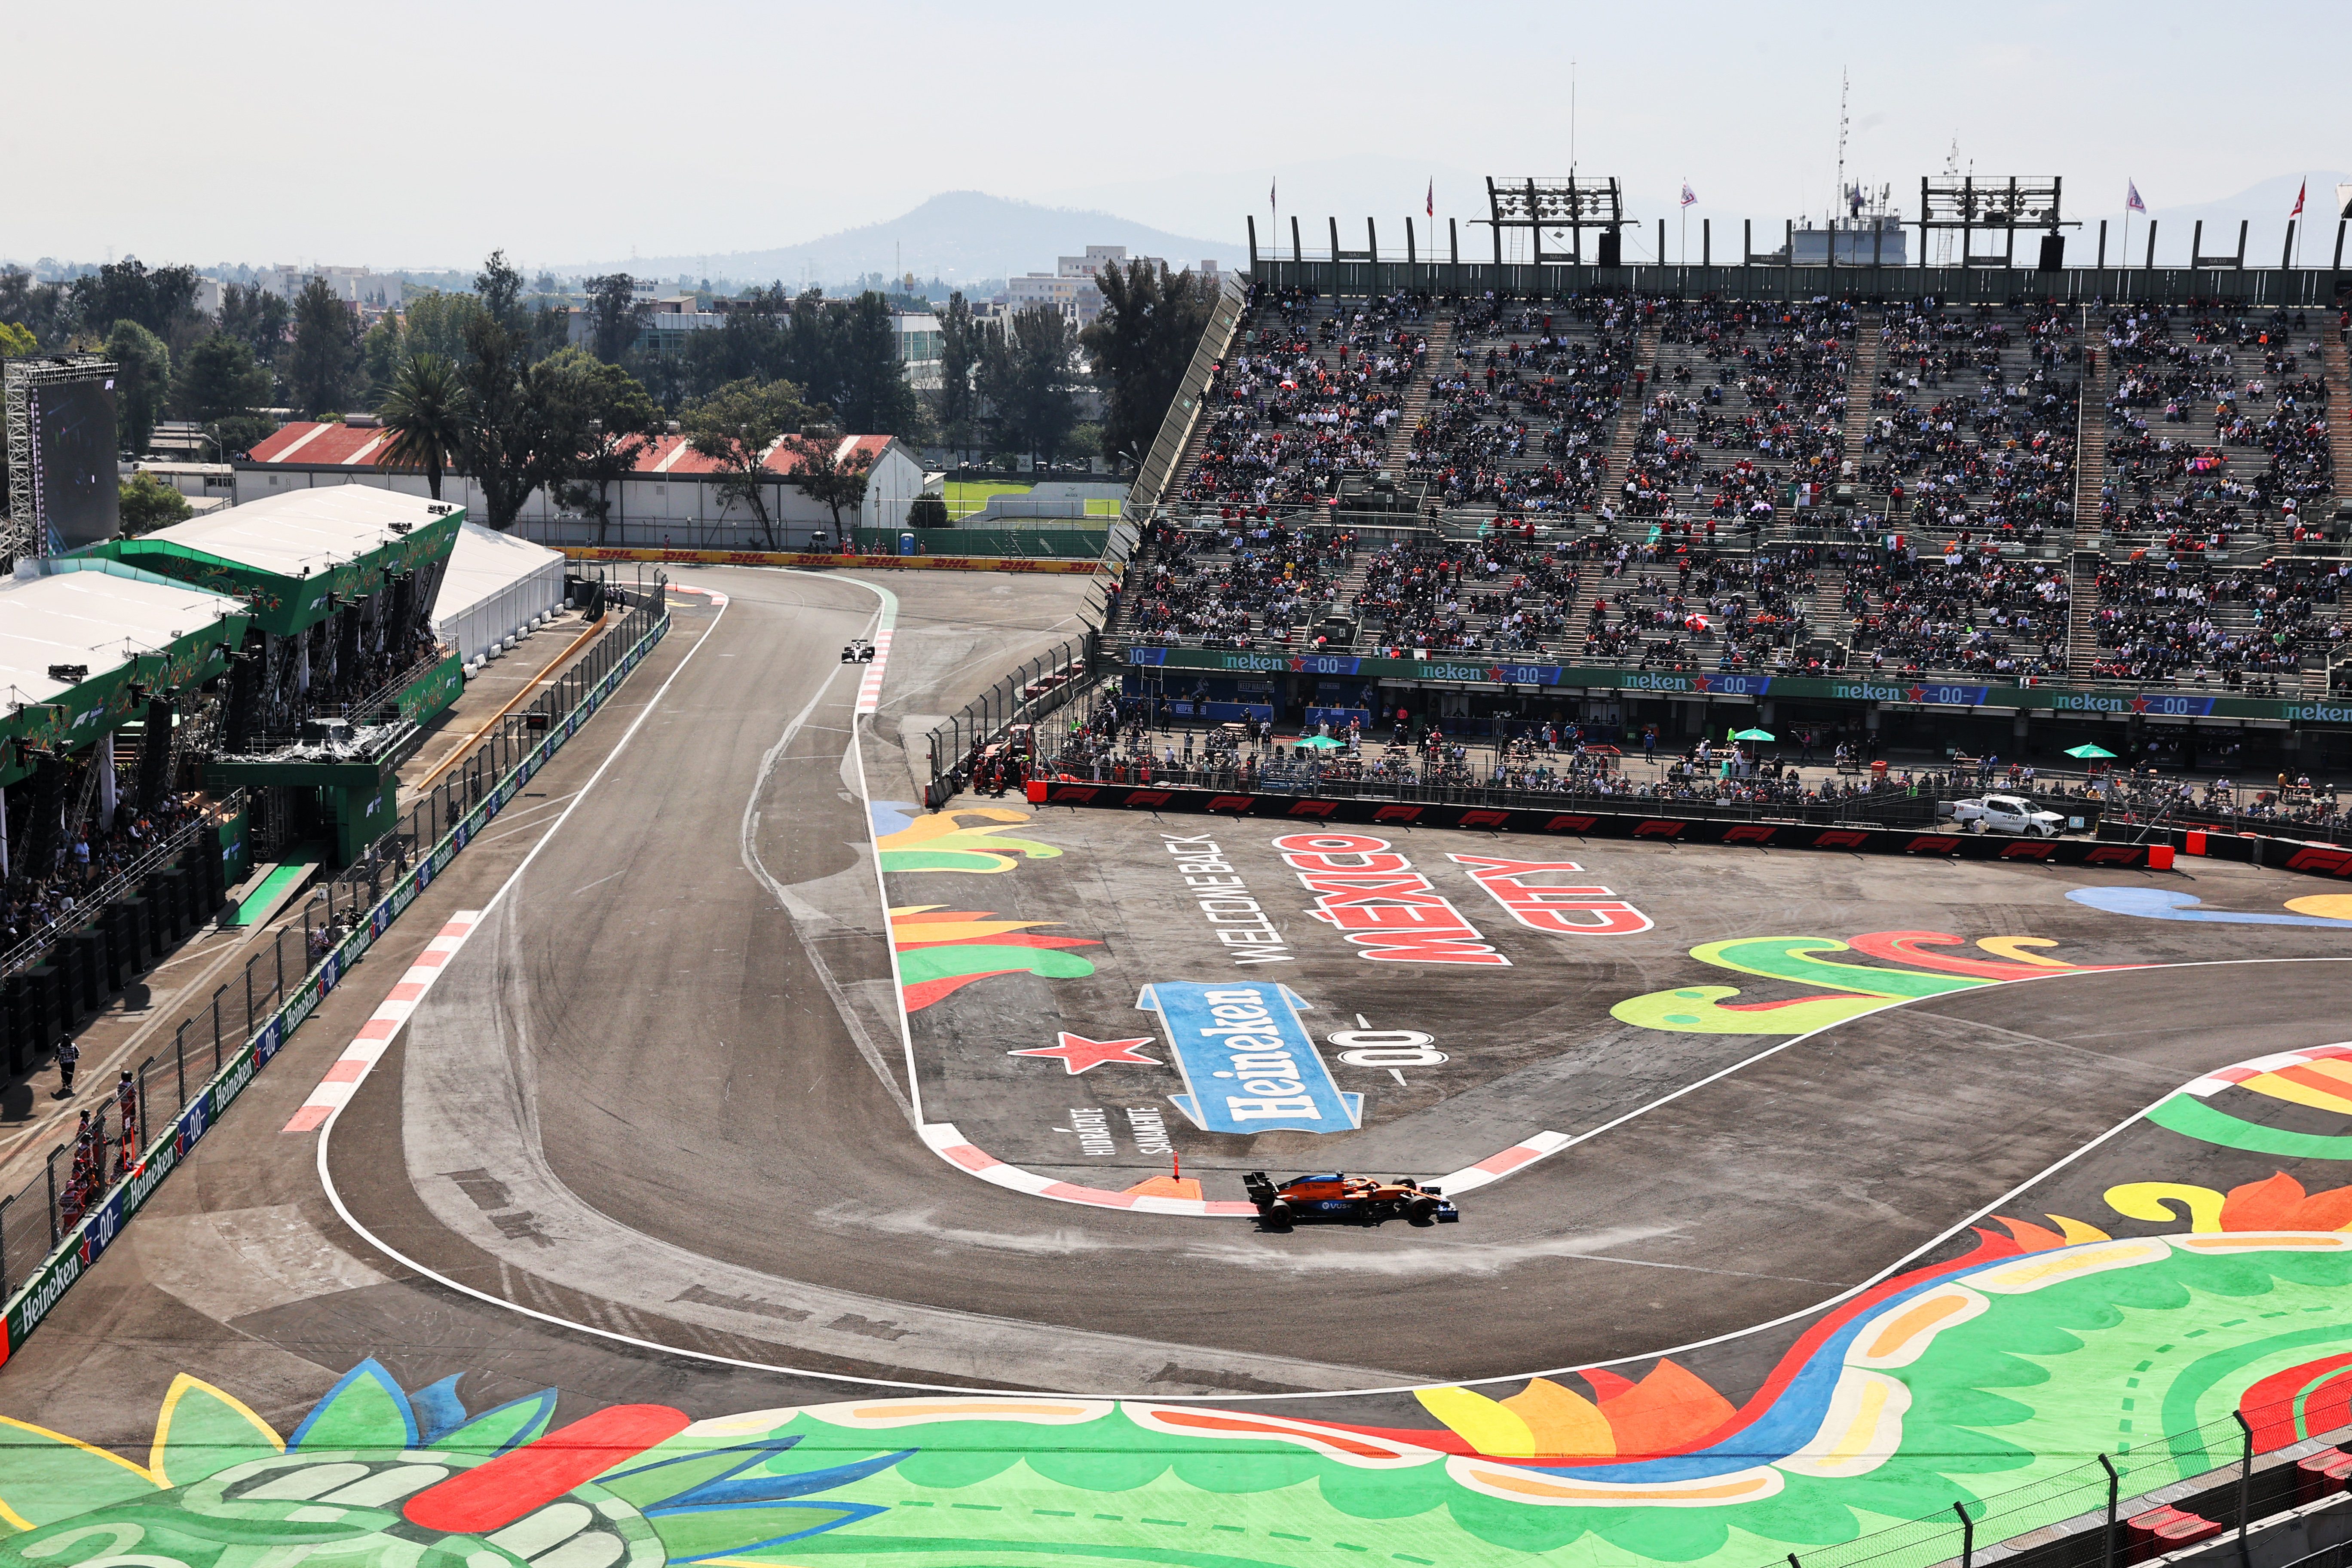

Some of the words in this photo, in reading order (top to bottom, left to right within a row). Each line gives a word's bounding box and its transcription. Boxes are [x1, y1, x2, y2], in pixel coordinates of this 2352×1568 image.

[597, 551, 634, 559] DHL
[662, 552, 699, 561] DHL
[729, 554, 766, 563] DHL
[796, 555, 835, 564] DHL
[864, 557, 903, 566] DHL
[932, 559, 971, 568] DHL
[999, 561, 1038, 570] DHL
[1069, 563, 1099, 572] DH
[1318, 658, 1338, 673] 0.0
[1518, 667, 1538, 683] 0.0
[1724, 677, 1746, 693] 0.0
[1940, 687, 1962, 704] 0.0
[2164, 698, 2187, 715] 0.0
[470, 810, 486, 836] Heineken
[434, 842, 453, 873] Heineken
[1160, 833, 1235, 873] BACK
[394, 882, 415, 916] Heineken
[1271, 833, 1513, 965] MÉXICO
[1445, 853, 1654, 935] CITY
[1185, 876, 1295, 965] WELCOME
[344, 928, 371, 968] Heineken
[286, 986, 318, 1034] Heineken
[1199, 989, 1323, 1122] Heineken
[1327, 1029, 1449, 1067] 0.0
[215, 1058, 252, 1113] Heineken
[266, 1027, 275, 1057] 0.0
[1127, 1103, 1174, 1155] SANAMENTE
[130, 1145, 174, 1210] Heineken
[190, 1108, 201, 1142] 0.0
[21, 1254, 79, 1334] Heineken
[100, 1207, 113, 1247] 0.0
